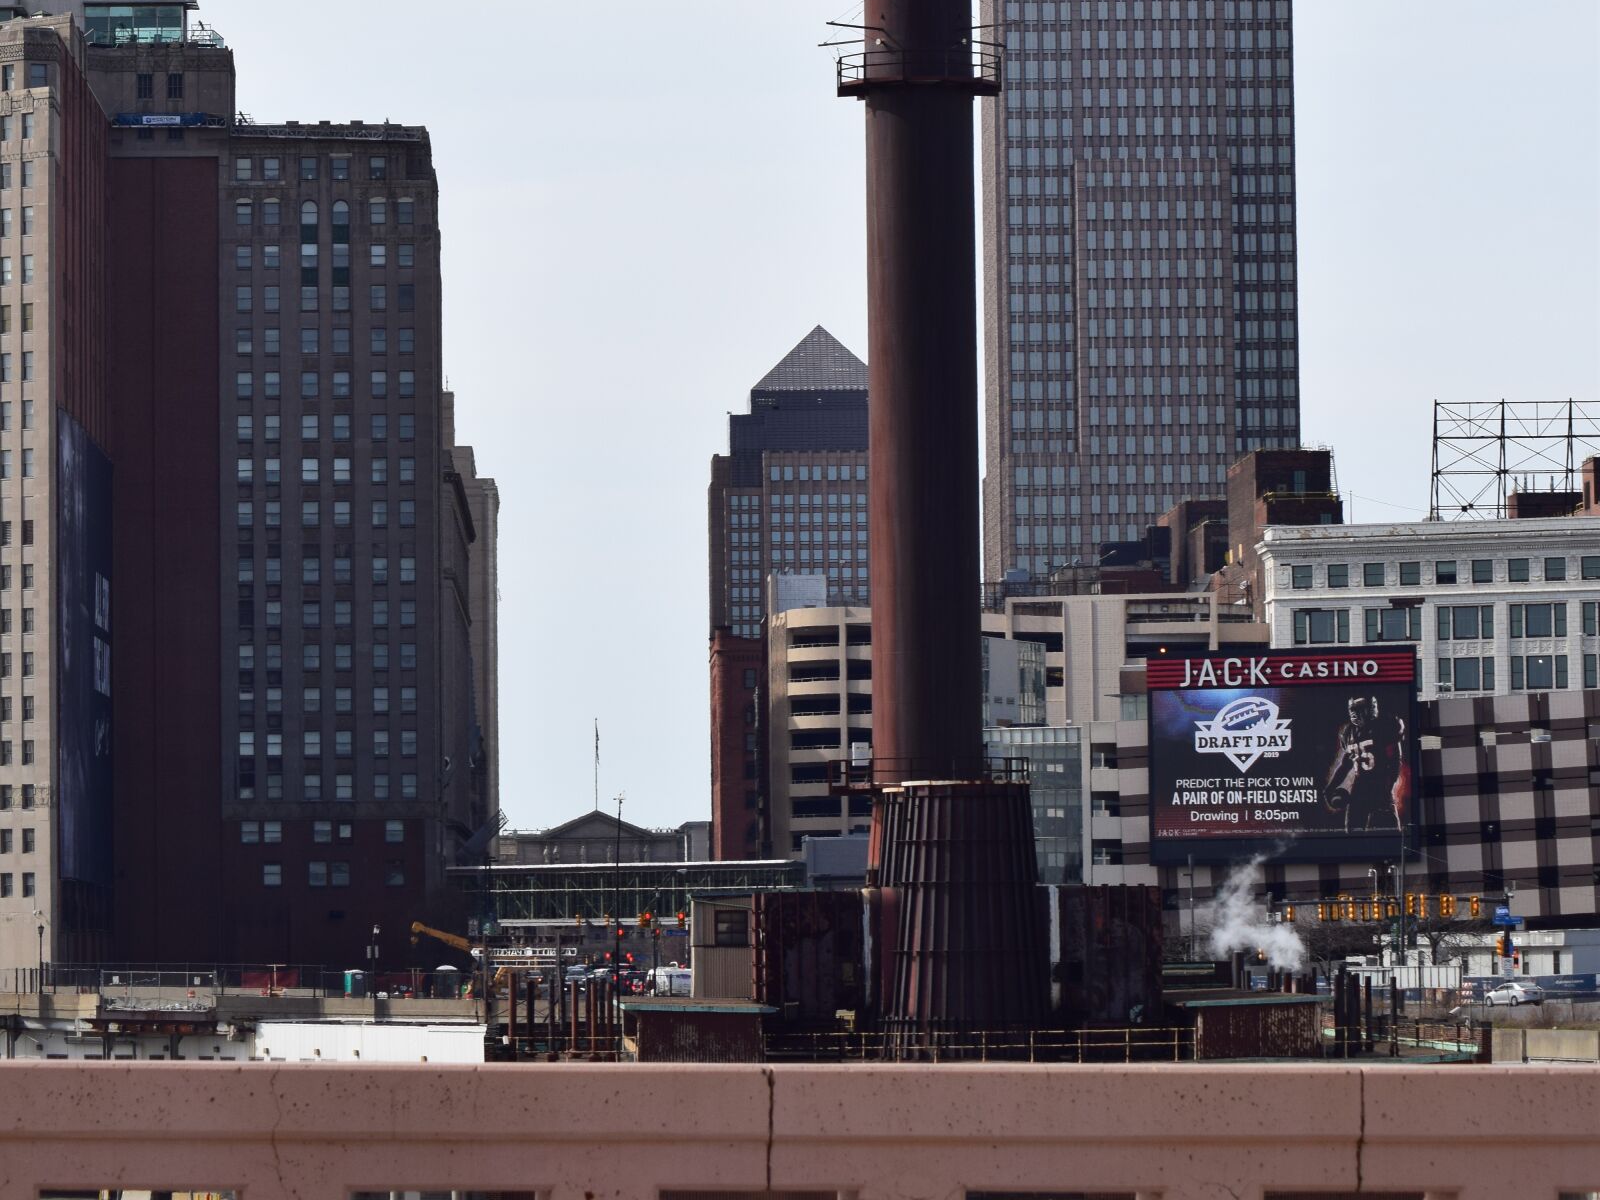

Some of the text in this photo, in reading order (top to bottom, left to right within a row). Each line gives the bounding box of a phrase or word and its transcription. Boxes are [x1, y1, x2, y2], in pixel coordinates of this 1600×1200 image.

[1179, 657, 1378, 687] JACK CASINO
[1198, 735, 1288, 748] DRAFT DAY
[1176, 776, 1314, 788] PREDICT THE PICK TO WIN
[1172, 789, 1318, 805] A PAIR OF ON-FIELD SEATS!
[1190, 809, 1299, 823] Drawing 8:05pm
